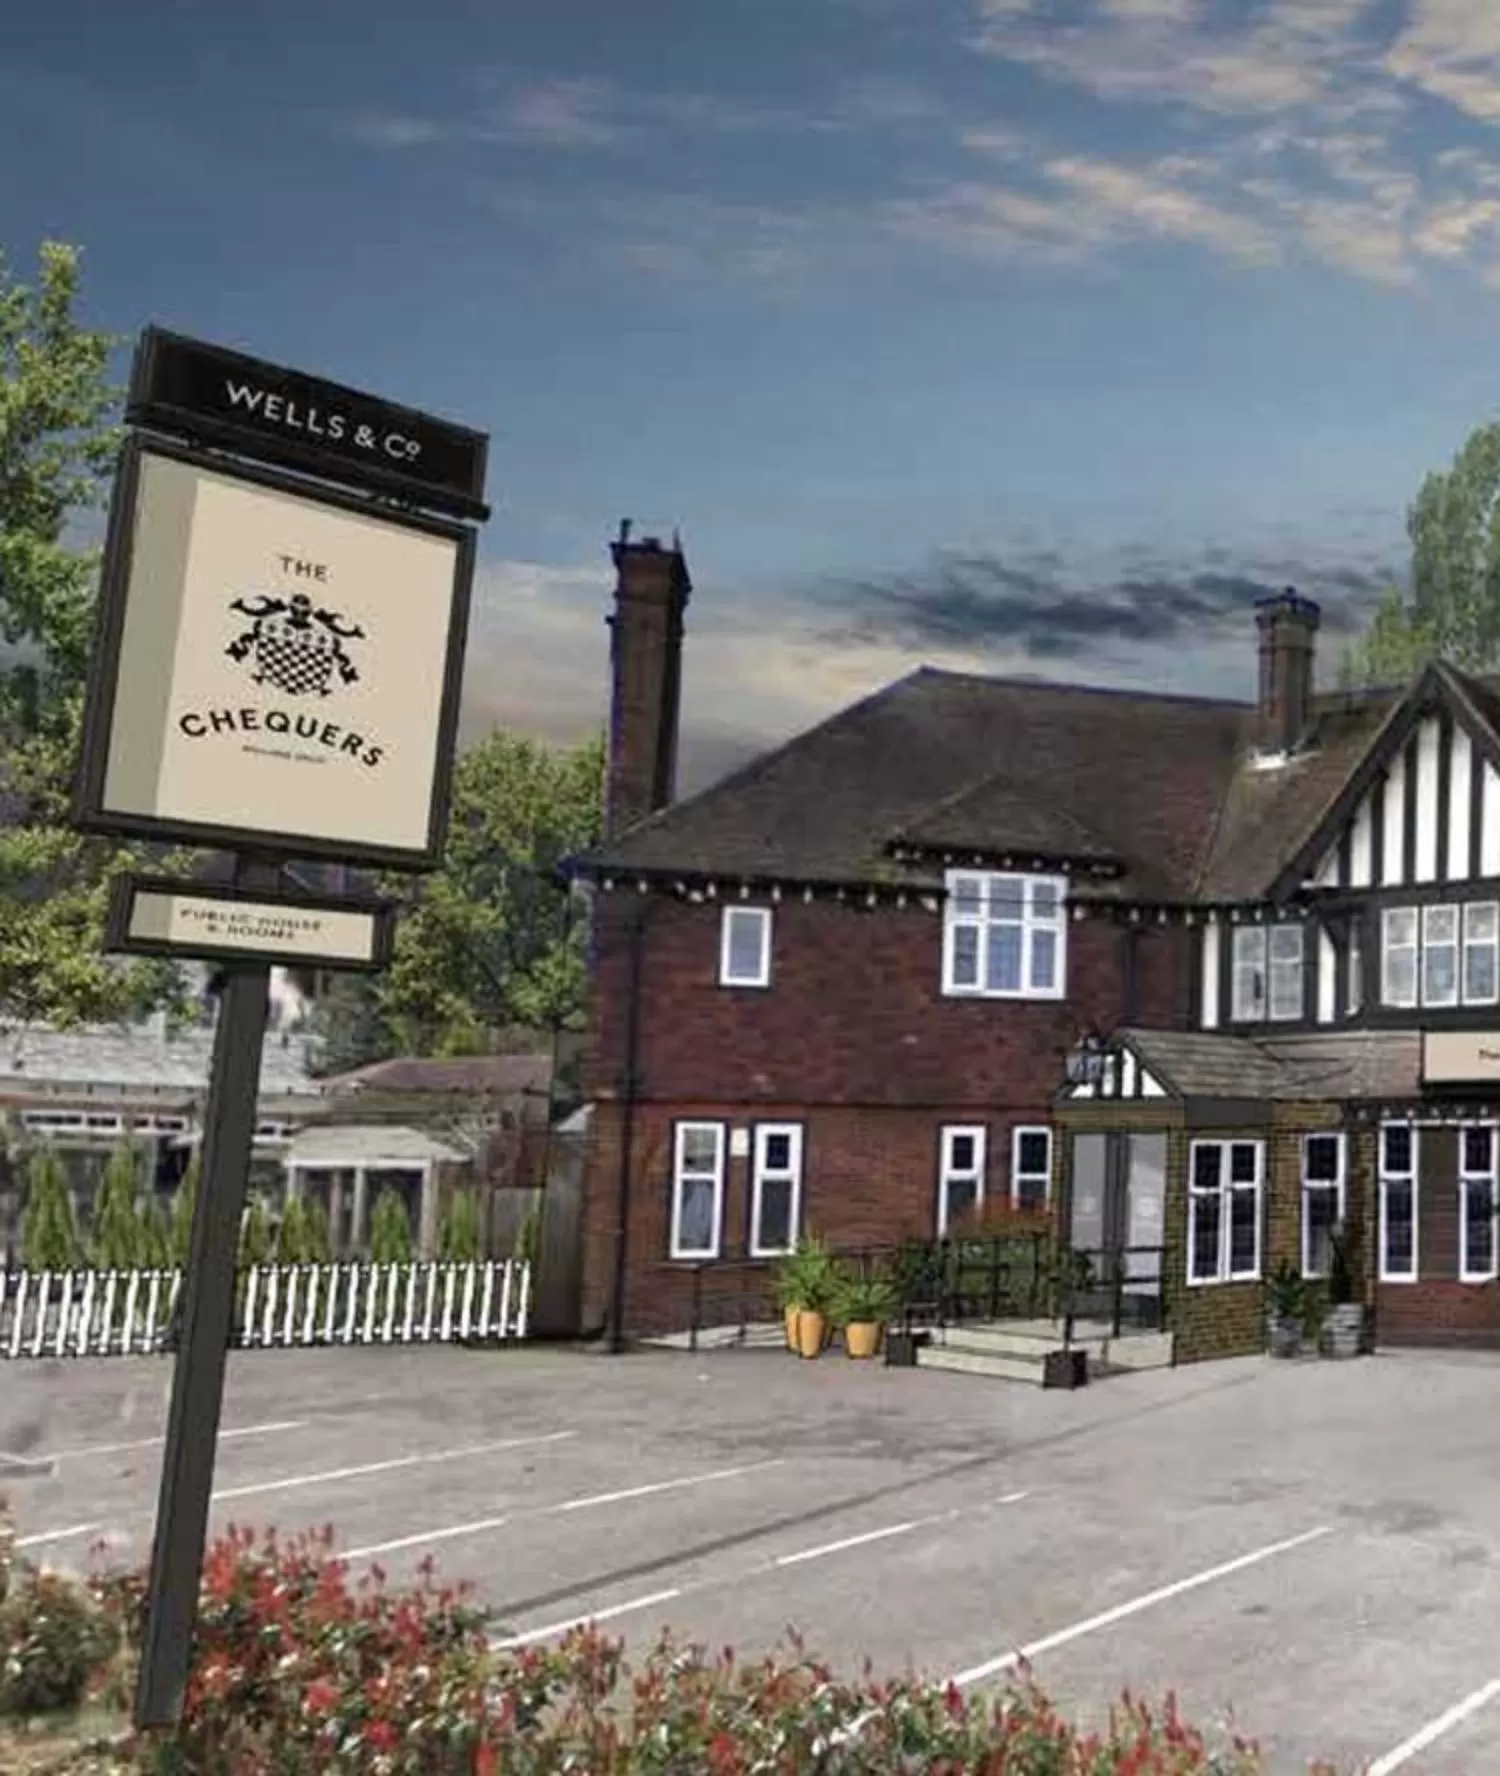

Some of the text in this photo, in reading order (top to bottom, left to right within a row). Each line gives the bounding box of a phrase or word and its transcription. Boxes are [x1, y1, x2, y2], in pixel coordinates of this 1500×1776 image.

[225, 379, 346, 439] WELLS
[353, 423, 377, 450] &
[278, 554, 329, 584] THE
[179, 708, 384, 767] CHEQUERS
